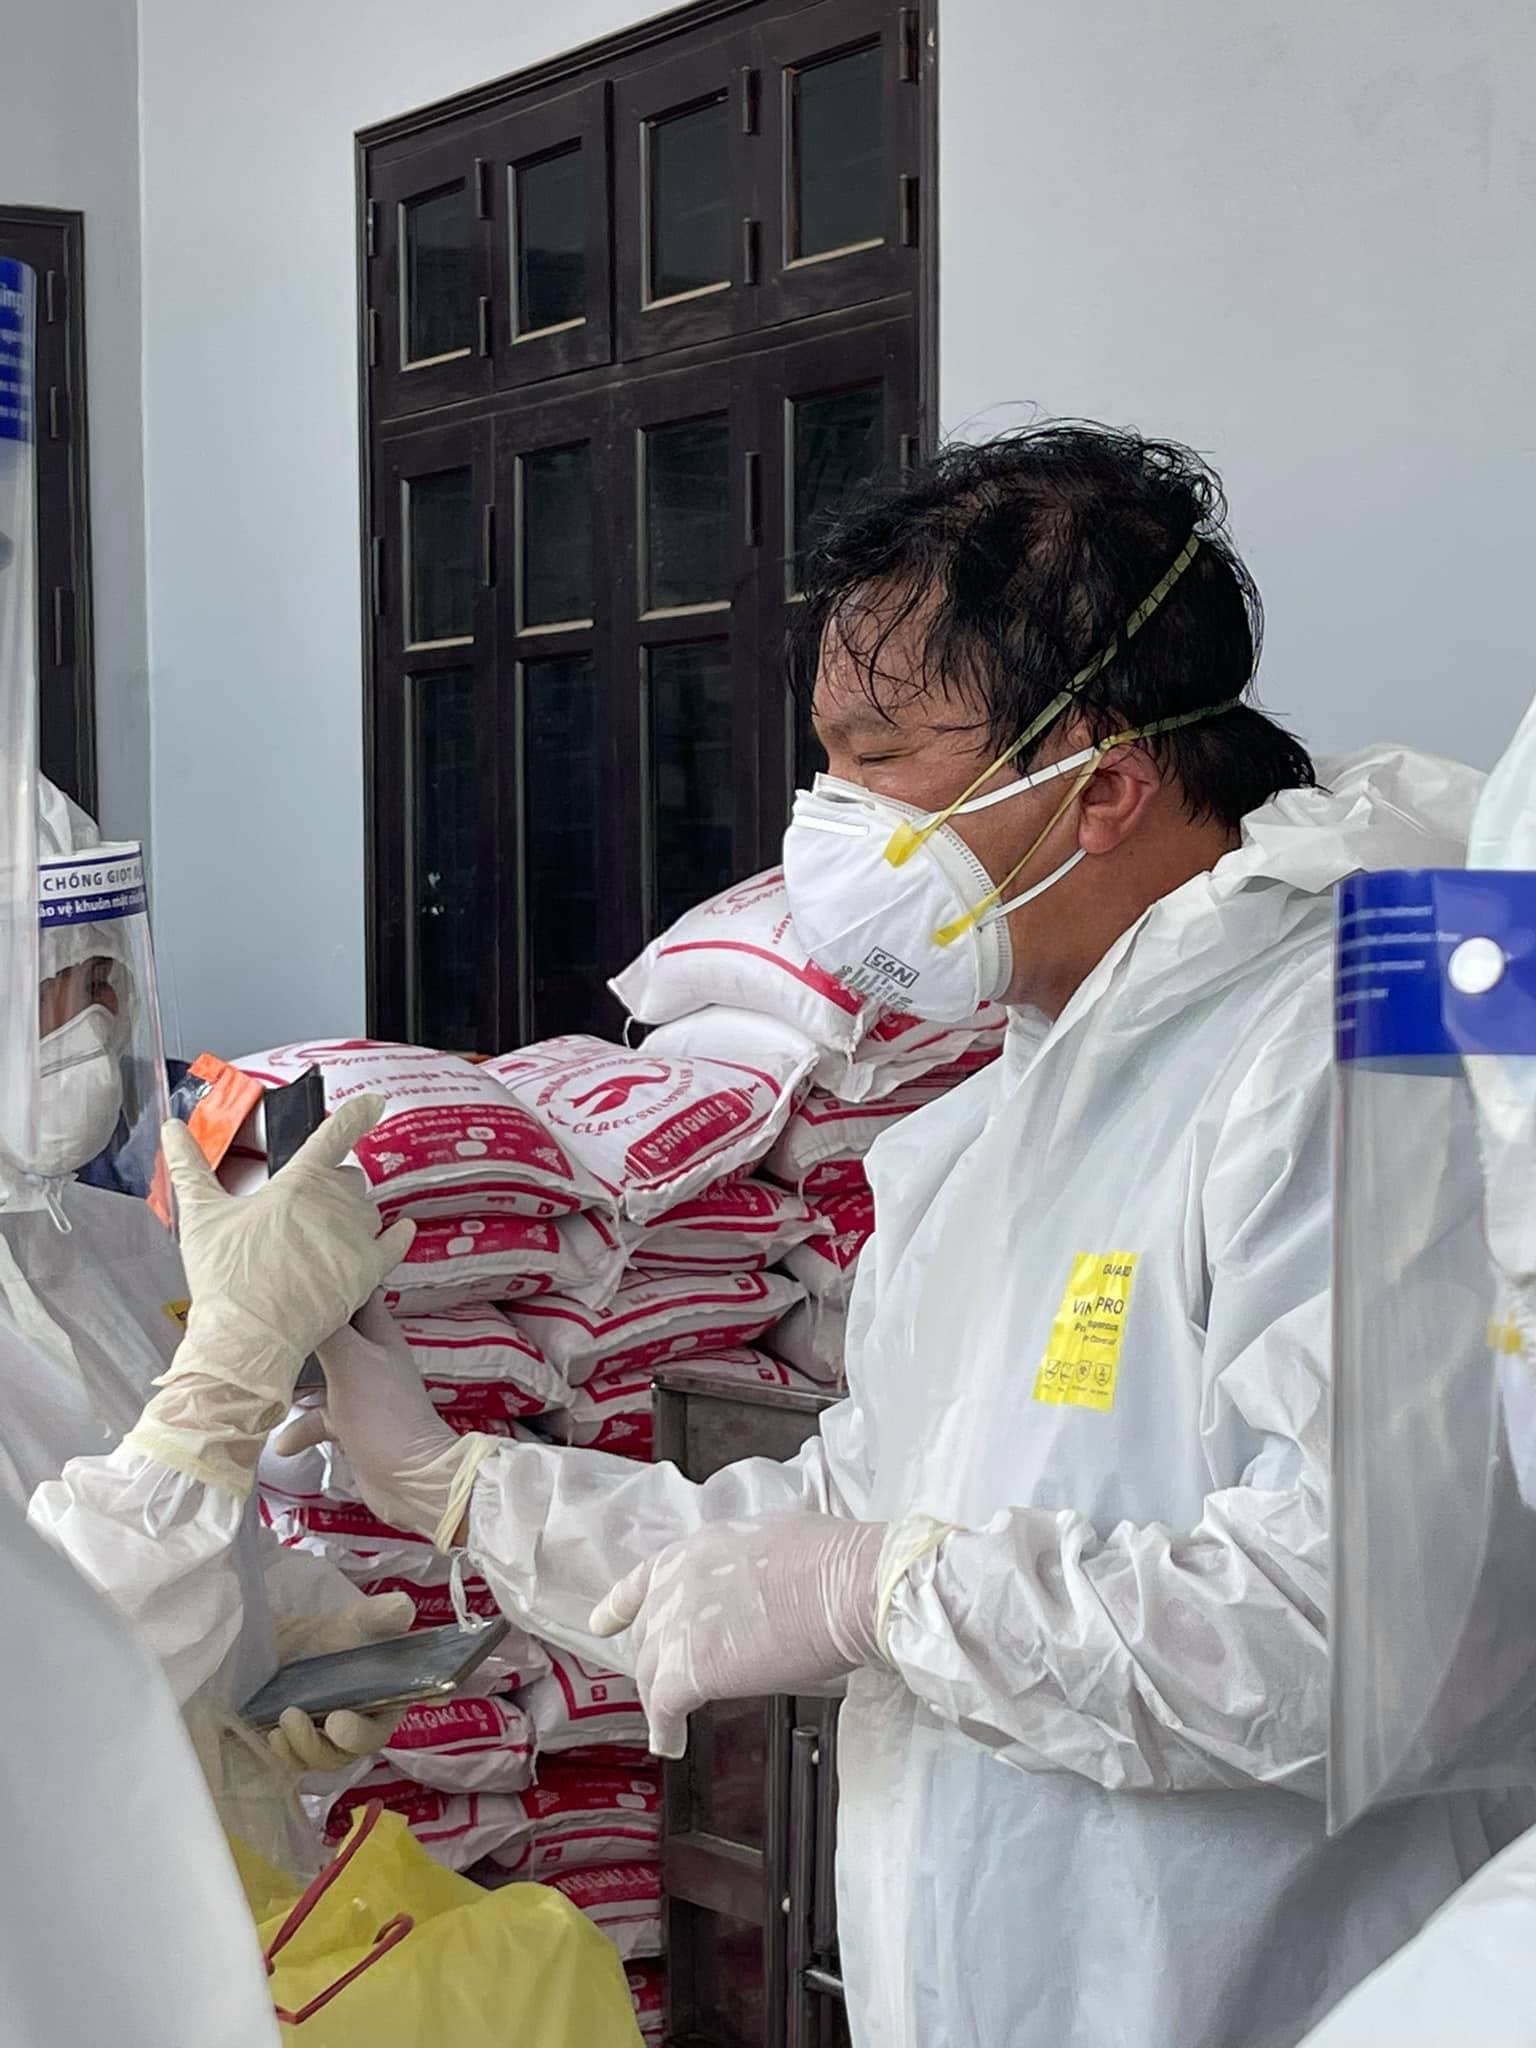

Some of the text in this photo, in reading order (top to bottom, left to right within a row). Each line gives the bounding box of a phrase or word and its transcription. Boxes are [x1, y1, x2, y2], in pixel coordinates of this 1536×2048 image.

[43, 872, 103, 892] CHỐNG
[57, 903, 73, 918] vệ
[872, 952, 915, 985] N95
[1095, 1296, 1125, 1315] PRO
